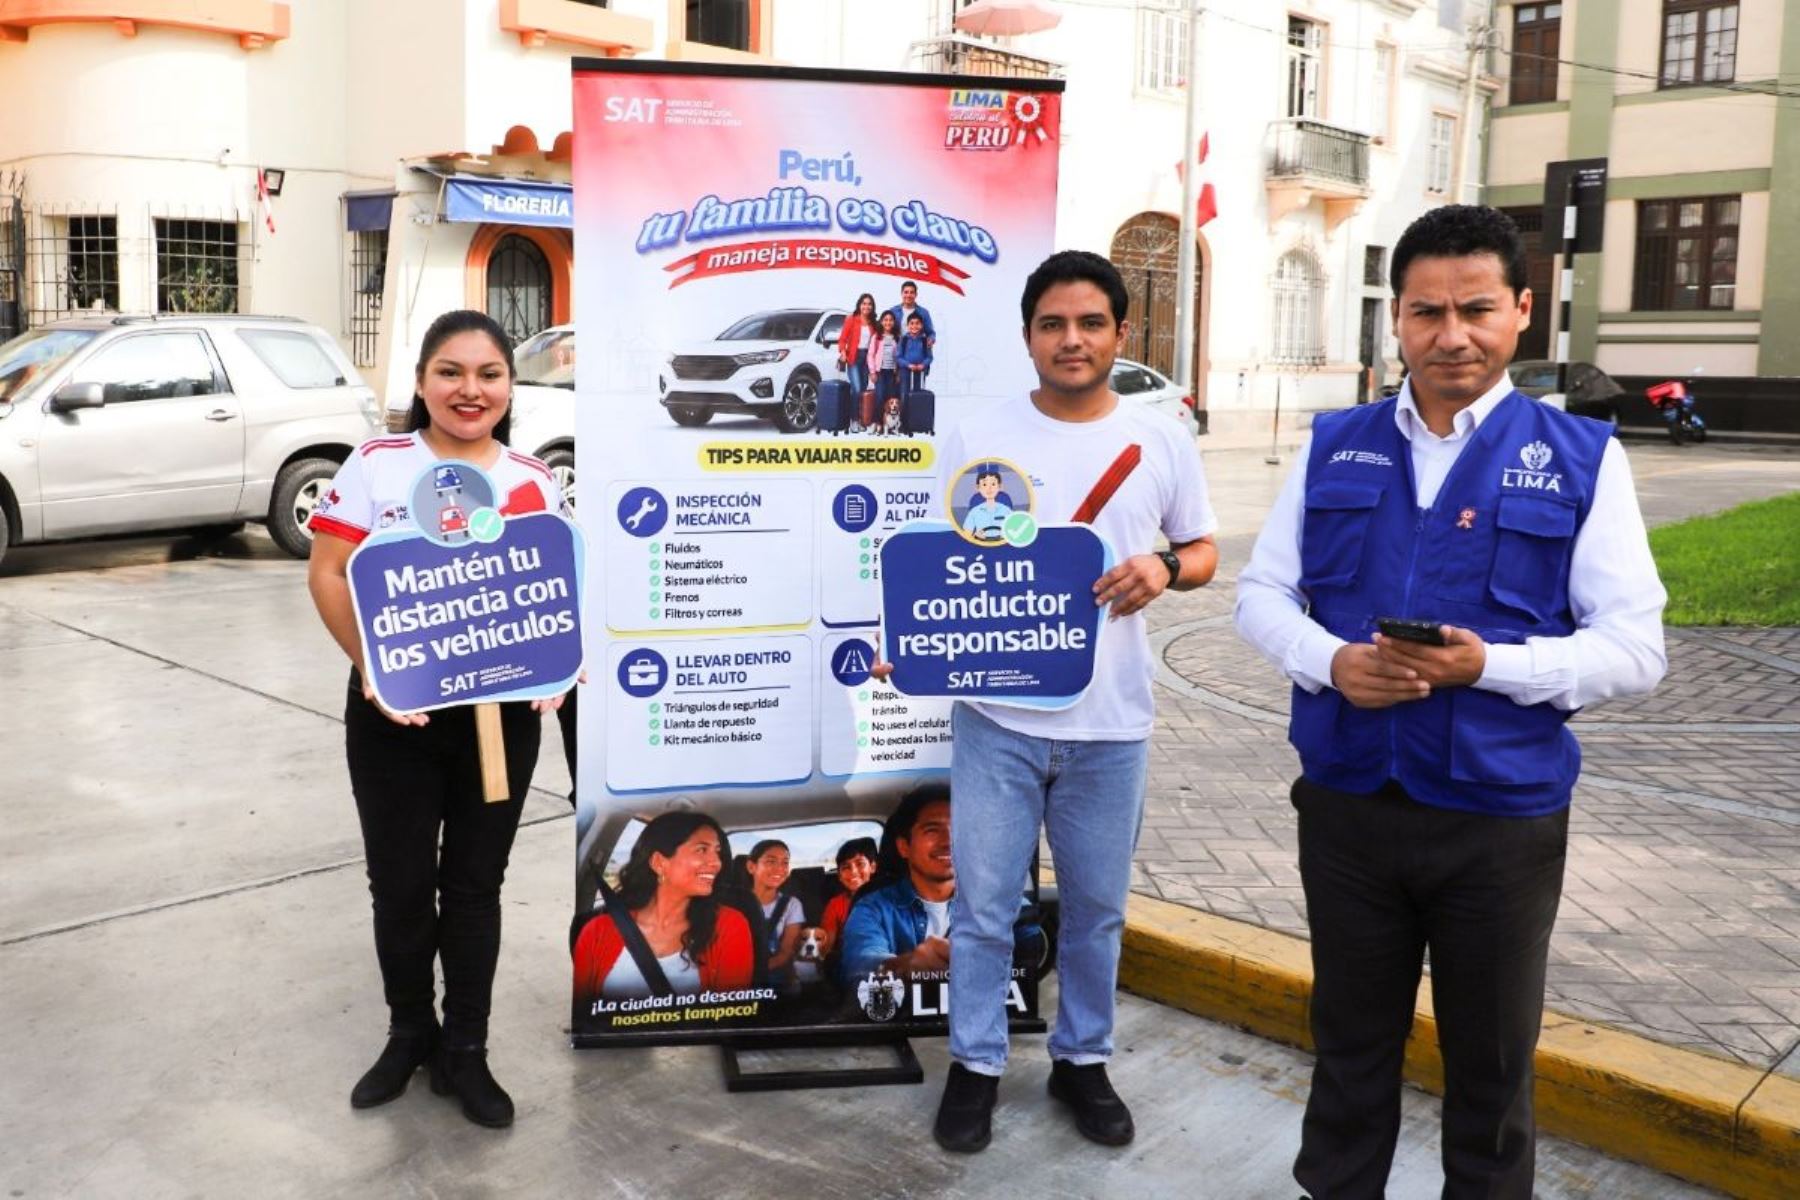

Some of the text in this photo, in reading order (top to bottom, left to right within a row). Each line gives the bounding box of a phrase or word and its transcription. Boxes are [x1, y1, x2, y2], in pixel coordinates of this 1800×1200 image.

[953, 91, 1003, 108] LIMA
[604, 96, 663, 123] SAT
[946, 121, 1010, 147] PERÚ
[779, 149, 861, 186] Perú,
[482, 194, 569, 216] FLORERÍA
[637, 186, 998, 264] tu familia es clave
[707, 243, 929, 275] maneja responsable
[707, 447, 922, 464] TIPS PARA VIAJAR SEGURO
[1502, 473, 1560, 494] LIMA
[676, 491, 761, 508] INSPECCIÓN
[676, 510, 751, 526] MECÁNICA
[885, 509, 902, 521] AL
[665, 543, 701, 554] Fluidos
[384, 546, 541, 599] Mantén tu
[665, 559, 723, 570] Neumáticos
[945, 554, 1034, 585] Sé un
[665, 574, 748, 587] Sistema eléctrico
[665, 592, 699, 603] Frenos
[912, 589, 1071, 620] conductor
[373, 577, 568, 638] distancia con
[665, 608, 742, 620] Filtros y correas
[378, 609, 575, 673] los vehículos
[899, 622, 1086, 661] responsable
[676, 651, 791, 669] LLEVAR DENTRO
[441, 671, 478, 696] SAT
[676, 671, 747, 686] DEL AUTO
[947, 671, 986, 688] SAT
[664, 697, 779, 714] Triángulos de seguridad
[664, 716, 756, 729] Llanta de repuesto
[872, 722, 885, 731] No
[908, 719, 917, 728] el
[919, 717, 950, 728] celular
[664, 731, 763, 745] Kit mecánico básico
[872, 737, 885, 746] No
[887, 735, 923, 746] excedas
[925, 733, 938, 743] los
[871, 749, 915, 761] velocidad
[1011, 968, 1026, 978] DE
[591, 988, 777, 1015] ¡La ciudad no descansa,
[913, 980, 1027, 1016] LIA
[612, 1003, 758, 1026] nosotros tampoco!
